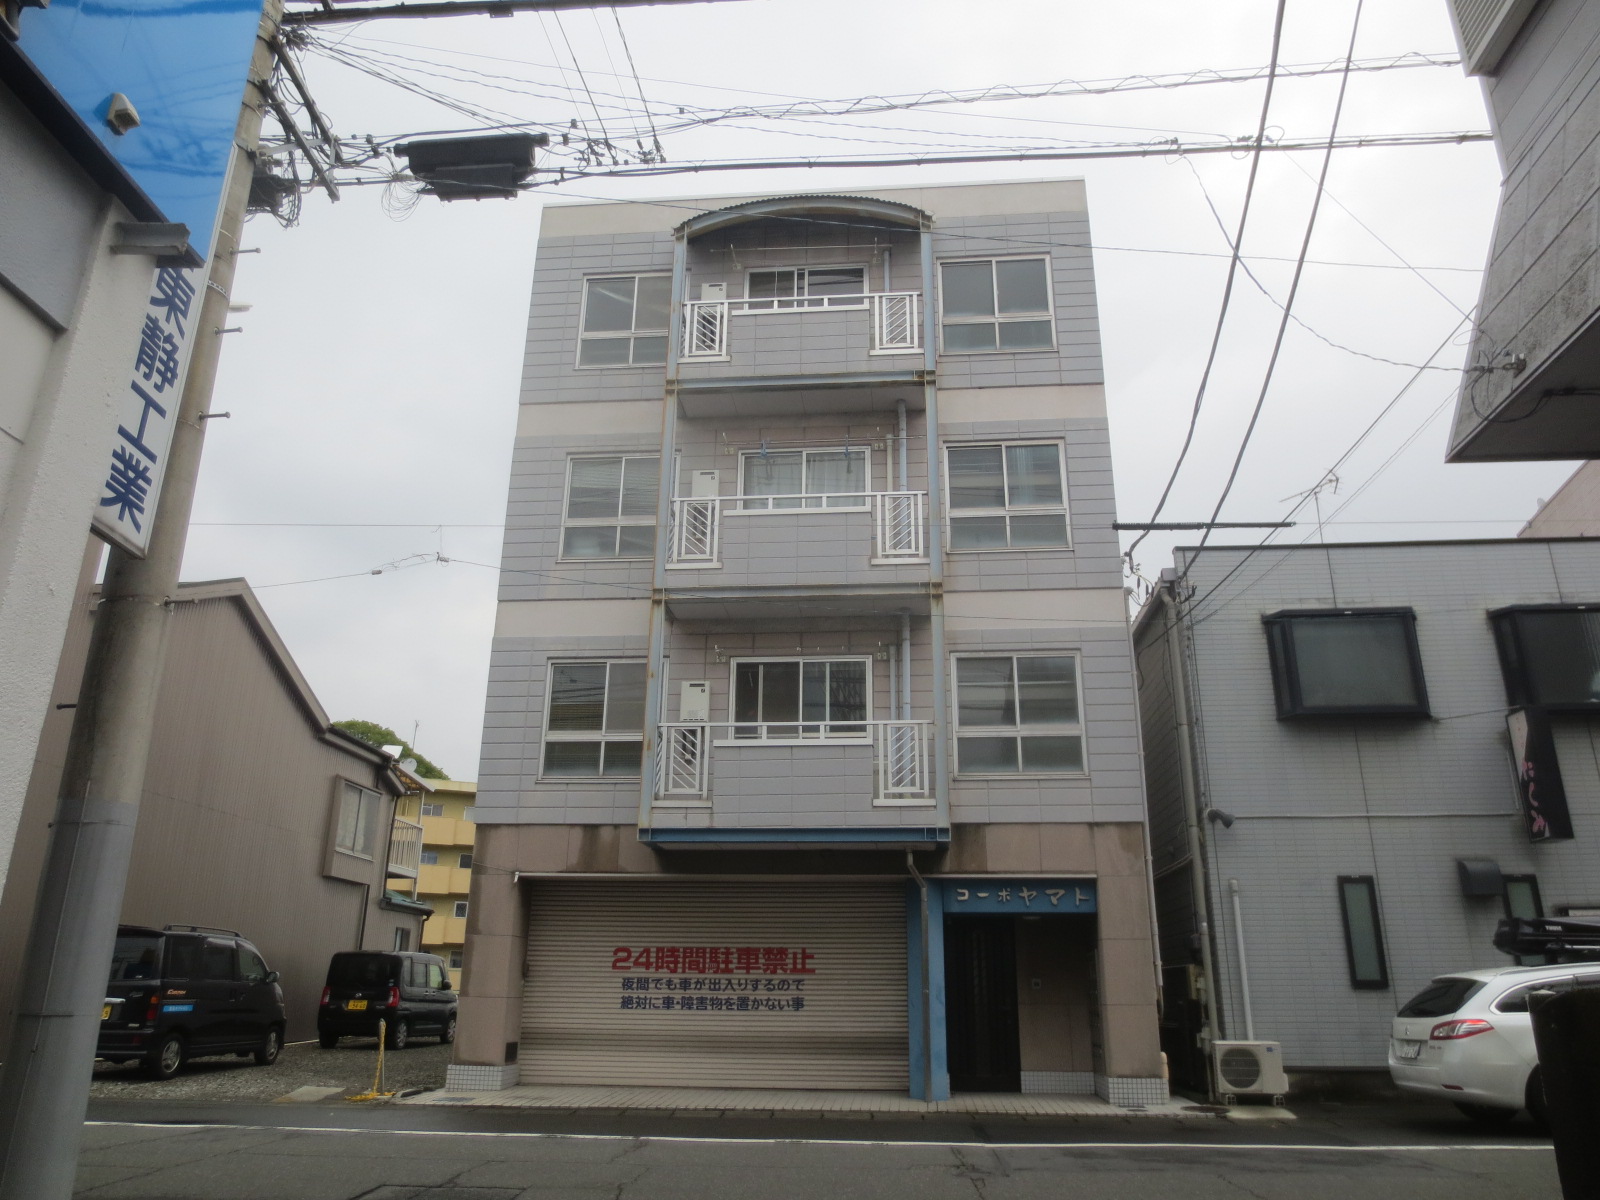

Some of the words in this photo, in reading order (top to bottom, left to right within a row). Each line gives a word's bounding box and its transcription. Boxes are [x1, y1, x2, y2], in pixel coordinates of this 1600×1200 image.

[100, 266, 196, 534] 東静工業
[956, 887, 1090, 907] コーポヤマト
[611, 947, 816, 974] 24時間駐車禁止
[621, 977, 805, 992] 夜間でも車が出入りするので
